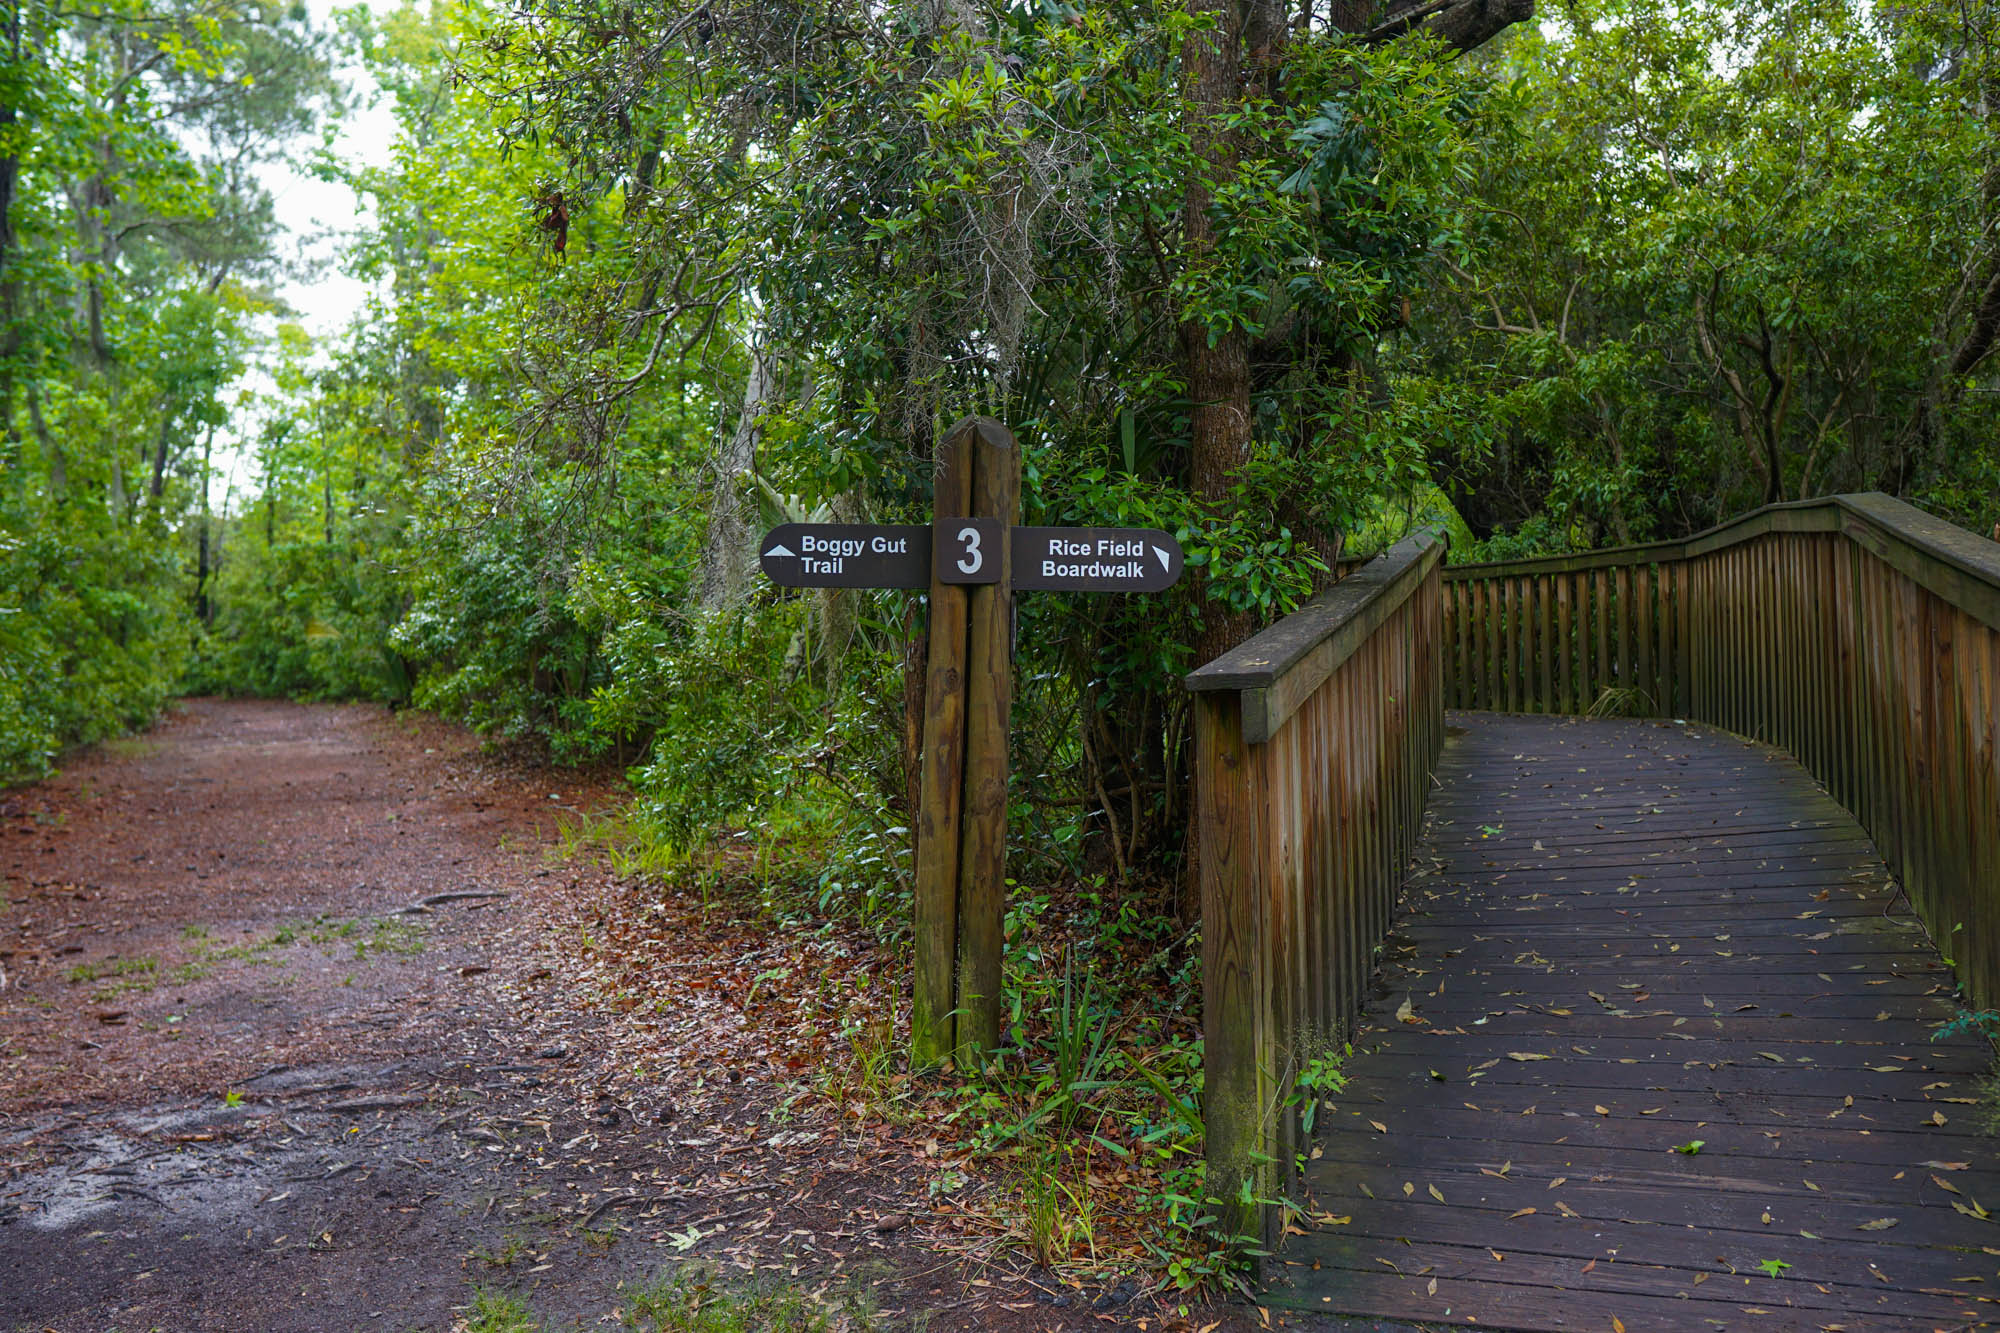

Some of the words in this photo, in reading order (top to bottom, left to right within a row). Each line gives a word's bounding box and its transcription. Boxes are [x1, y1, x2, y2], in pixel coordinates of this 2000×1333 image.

[802, 535, 865, 557] Boggy
[871, 536, 907, 554] Gut
[956, 527, 983, 574] 3
[1049, 539, 1091, 556] Rice
[1097, 539, 1144, 557] Field
[801, 557, 843, 574] Trail
[1042, 560, 1144, 578] Boardwalk
